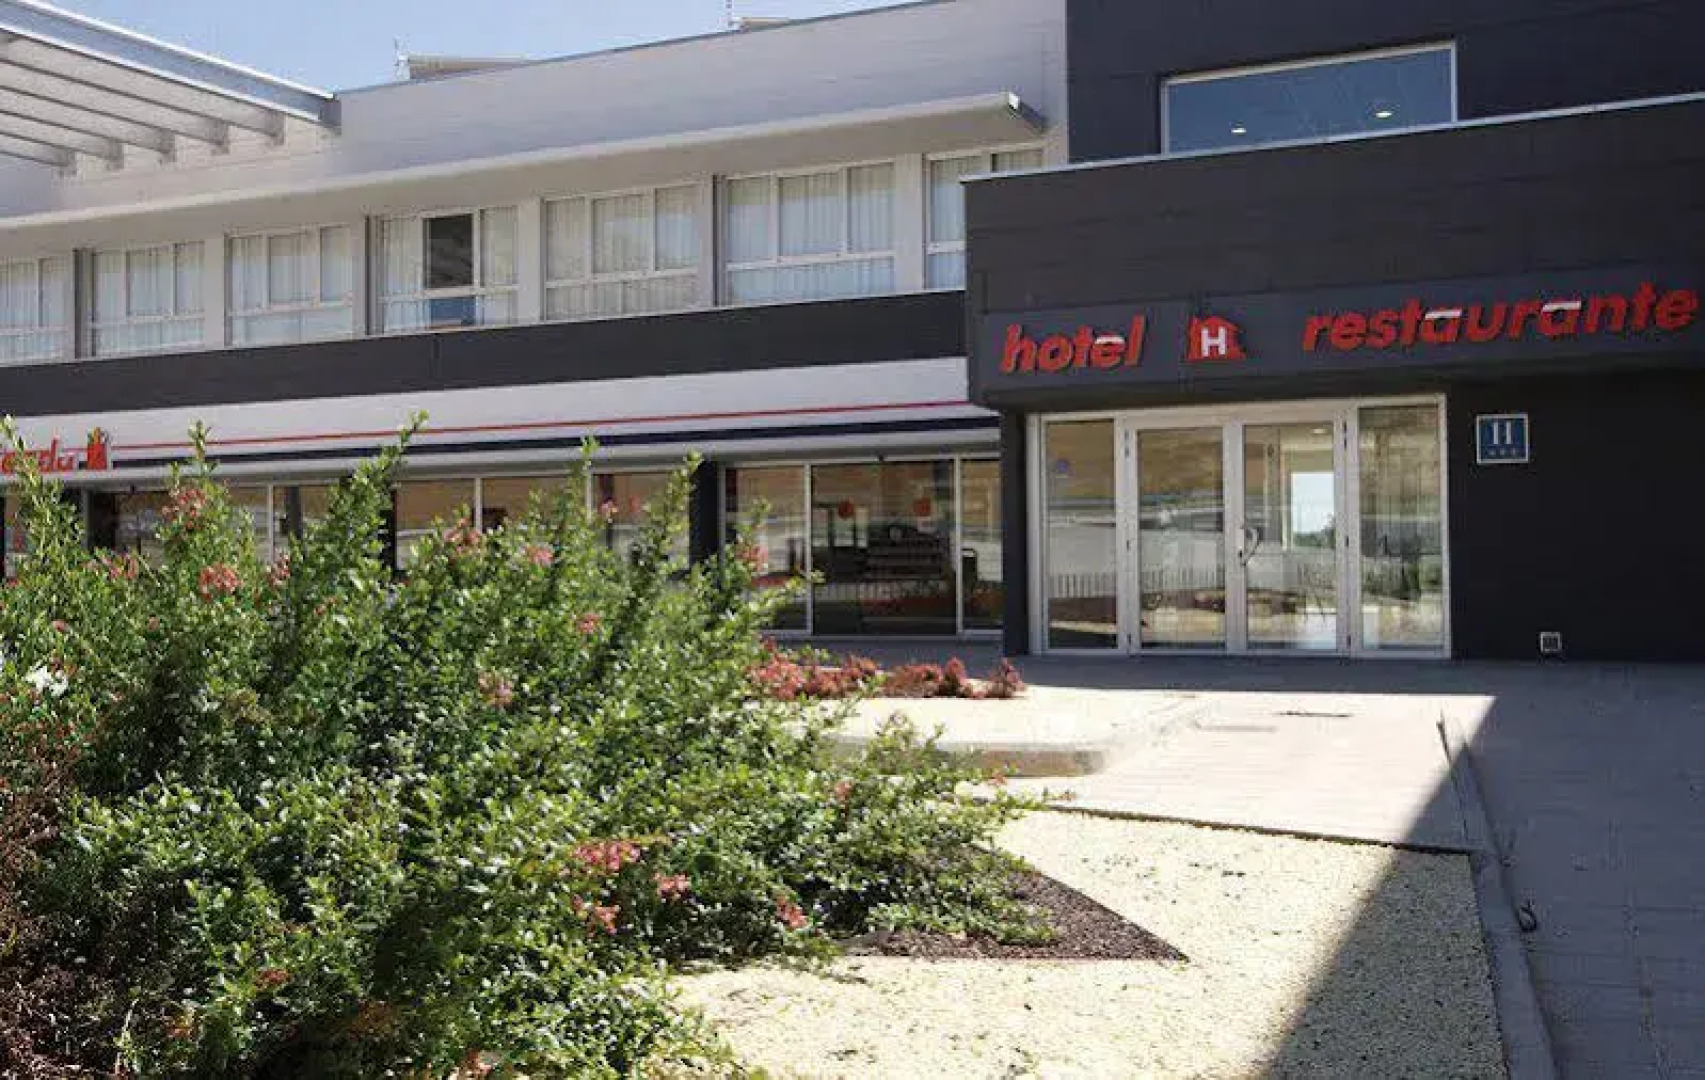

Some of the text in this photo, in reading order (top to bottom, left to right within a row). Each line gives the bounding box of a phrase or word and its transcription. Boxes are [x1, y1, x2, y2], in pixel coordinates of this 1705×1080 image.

[1000, 280, 1696, 373] hotel H restaurante
